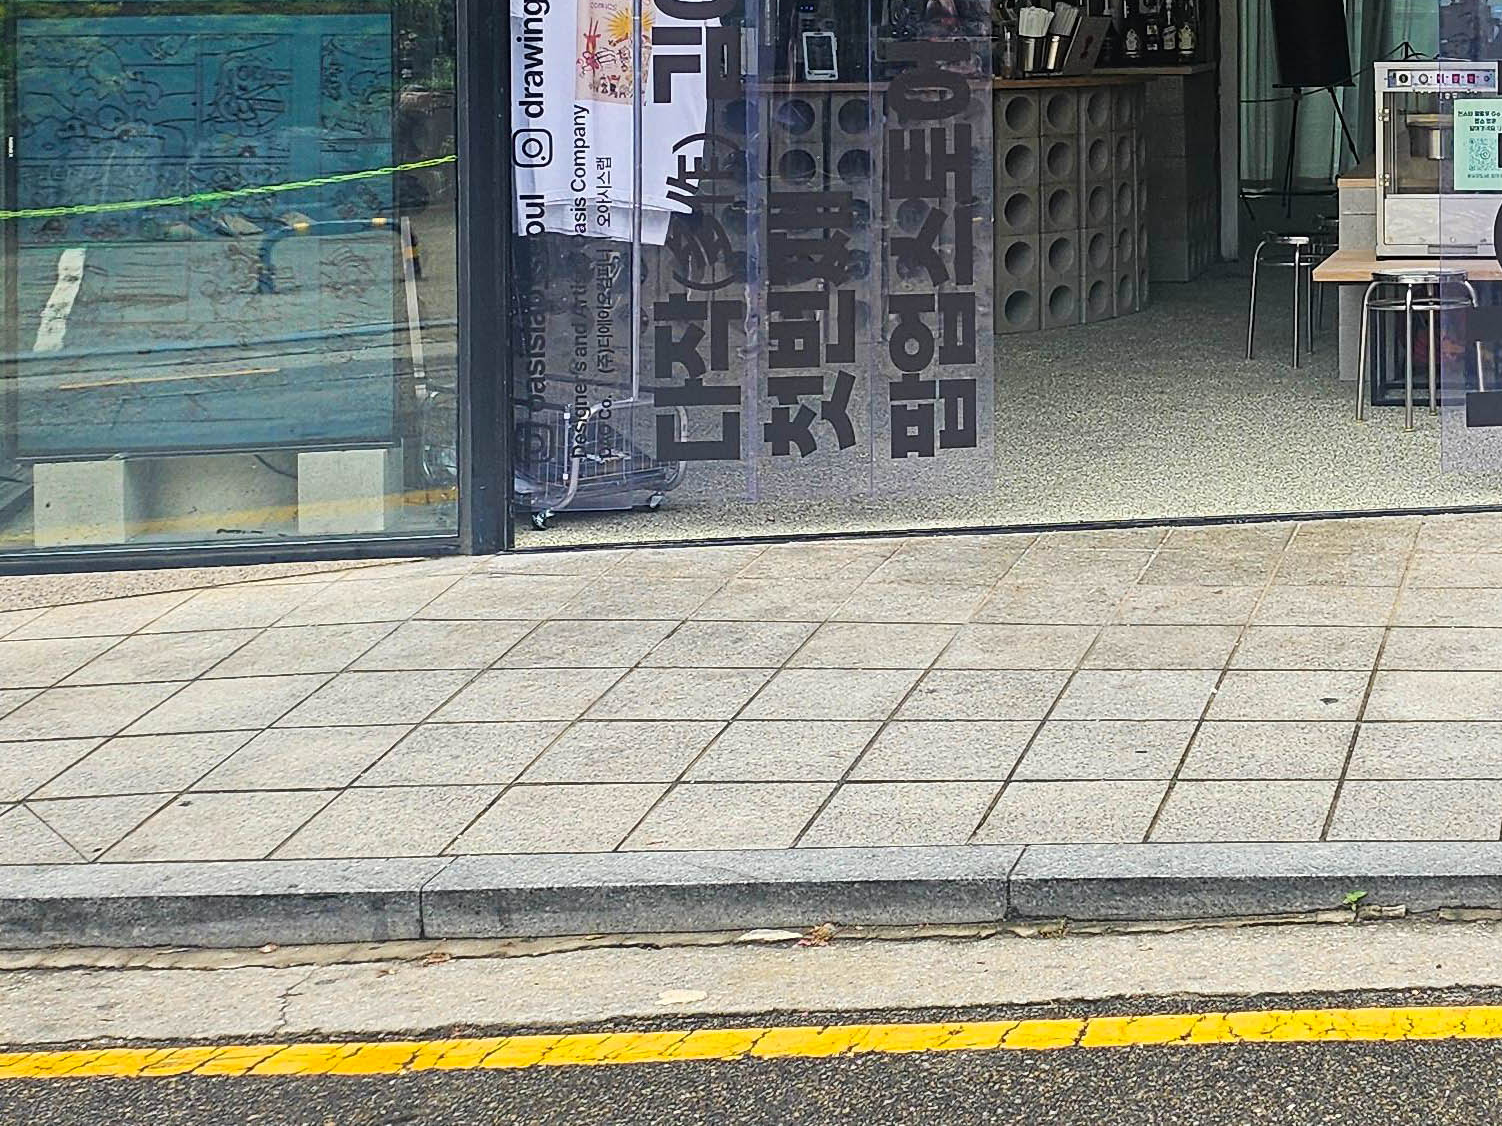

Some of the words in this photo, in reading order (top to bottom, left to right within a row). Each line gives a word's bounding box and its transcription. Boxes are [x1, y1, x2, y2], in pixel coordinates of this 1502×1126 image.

[569, 104, 592, 193] Company
[595, 156, 613, 228] 오아시스랩
[653, 133, 743, 461] 다작(多作)
[764, 190, 857, 458] 첫번째
[889, 38, 978, 460] 팝업스토어
[571, 324, 589, 356] and
